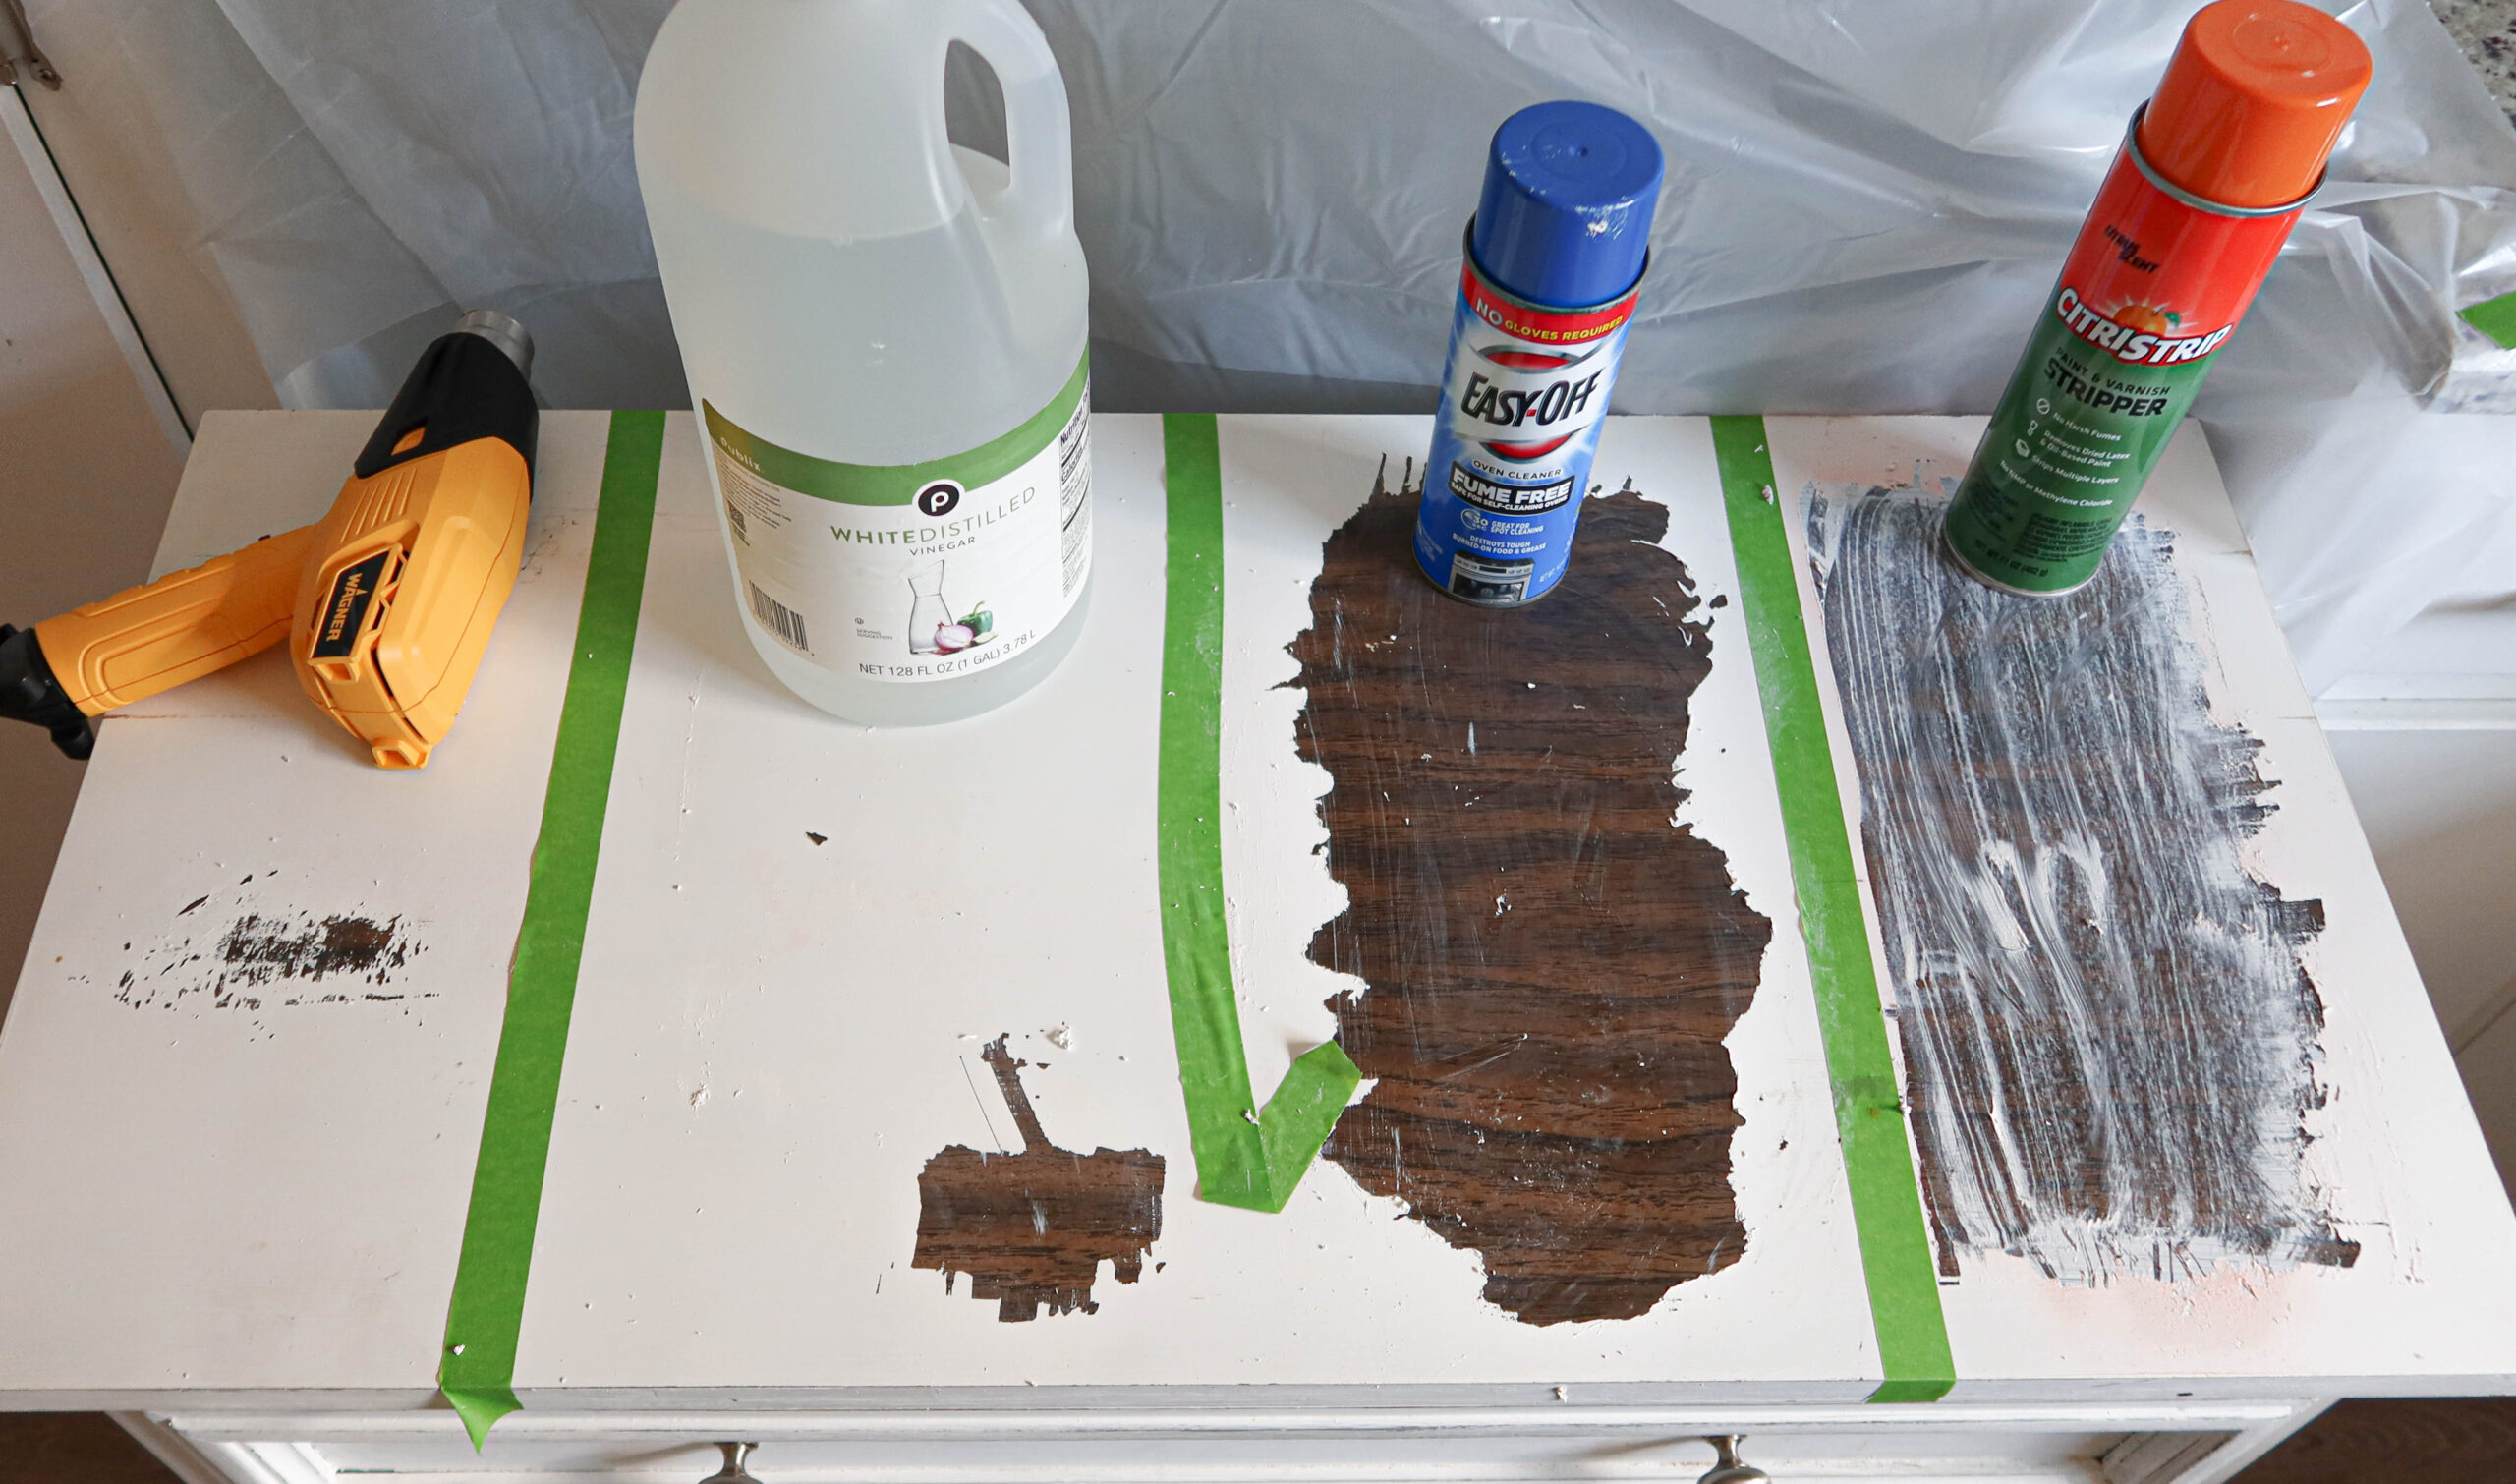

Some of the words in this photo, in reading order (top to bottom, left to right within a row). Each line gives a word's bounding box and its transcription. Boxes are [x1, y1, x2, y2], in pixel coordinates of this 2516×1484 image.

[1476, 298, 1503, 325] NO
[1505, 320, 1559, 340] GLOVES
[1562, 315, 1623, 340] REQUIRED
[2057, 288, 2233, 363] CITRISTRIP
[2056, 346, 2088, 374] PAINT
[2091, 374, 2101, 383] &
[2107, 379, 2171, 395] VARNISH
[1460, 367, 1606, 427] EASY-OFF
[2044, 357, 2167, 416] STRIPPER
[2052, 413, 2065, 424] No
[2065, 420, 2089, 434] Harsh
[2091, 429, 2121, 441] Fumes
[2044, 430, 2080, 452] Removes
[2082, 448, 2106, 458] Dried
[2047, 443, 2086, 464] Oil-Based
[2087, 458, 2112, 467] Paint
[1473, 460, 1504, 477] OVEN
[1508, 468, 1562, 480] CLEANER
[2032, 455, 2054, 472] Strips
[2055, 468, 2090, 483] Multiple
[2091, 477, 2120, 485] Layers
[1453, 467, 1512, 503] FUME
[1515, 481, 1572, 504] FREE
[2034, 487, 2080, 506] Methylene
[1467, 492, 1483, 503] FOR
[1483, 499, 1543, 511] SELF-CLEANING
[1544, 494, 1568, 508] OVENS
[1453, 533, 1491, 552] BURNED-ON
[1521, 542, 1547, 554] GREASE
[1470, 535, 1505, 548] DESTROYS
[1510, 525, 1544, 536] CLEANING
[909, 536, 976, 556] VINEGAR
[326, 573, 363, 642] WAGNER
[859, 663, 884, 675] NET
[889, 666, 913, 676] 128
[917, 665, 933, 676] FL
[937, 662, 954, 674] OZ
[958, 659, 968, 671] (1
[974, 649, 1000, 665] GAL)
[1003, 634, 1027, 654] 3.78
[1030, 629, 1036, 639] L
